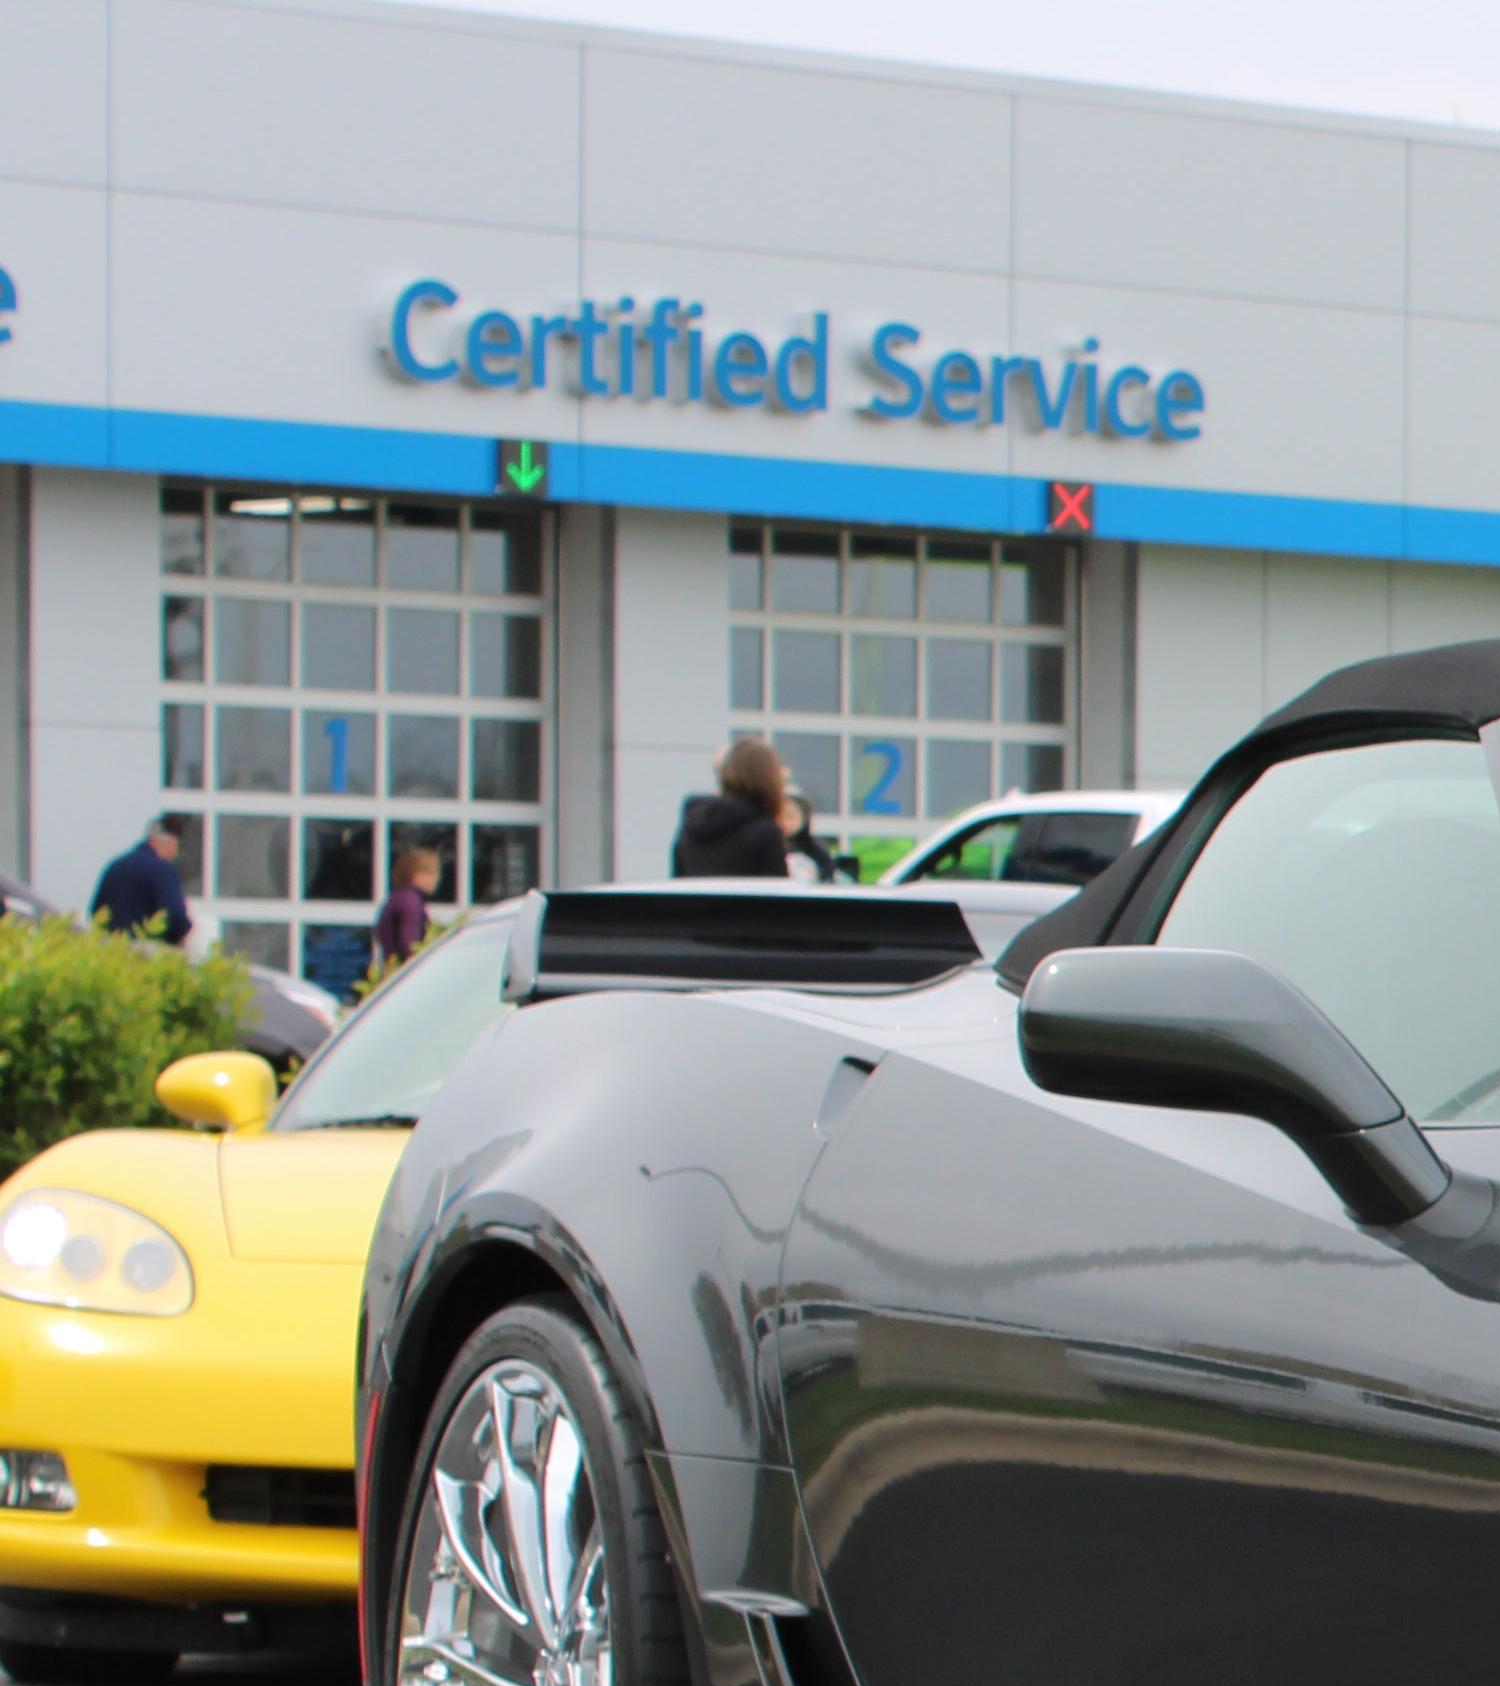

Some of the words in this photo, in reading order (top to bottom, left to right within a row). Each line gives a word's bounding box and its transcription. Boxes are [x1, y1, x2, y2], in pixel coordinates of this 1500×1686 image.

[390, 278, 830, 413] Certified
[868, 322, 1207, 442] Service
[324, 718, 349, 794] 1
[861, 741, 904, 815] 2
